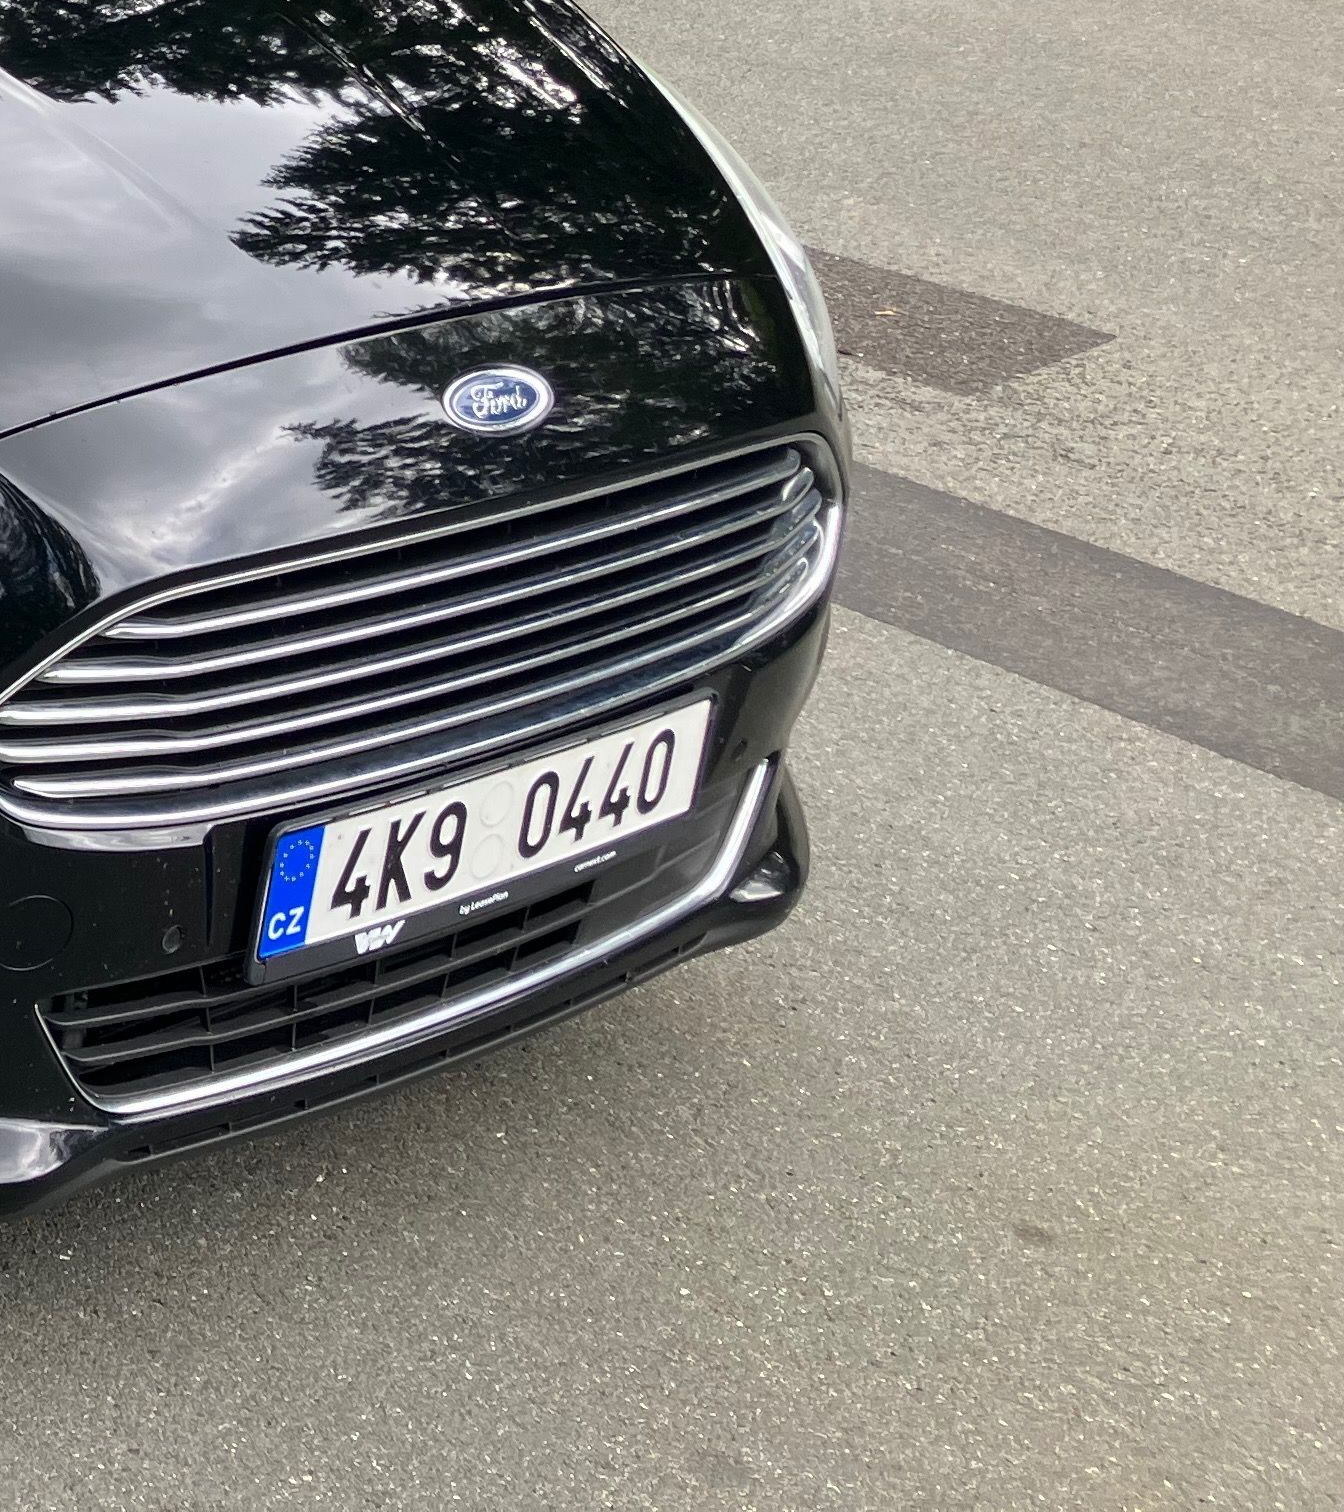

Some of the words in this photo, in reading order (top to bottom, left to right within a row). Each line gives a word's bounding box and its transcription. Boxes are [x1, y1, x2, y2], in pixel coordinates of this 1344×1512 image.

[470, 381, 528, 419] Ford
[329, 800, 468, 920] 4K9
[517, 728, 676, 859] 0440
[267, 906, 305, 940] CZ
